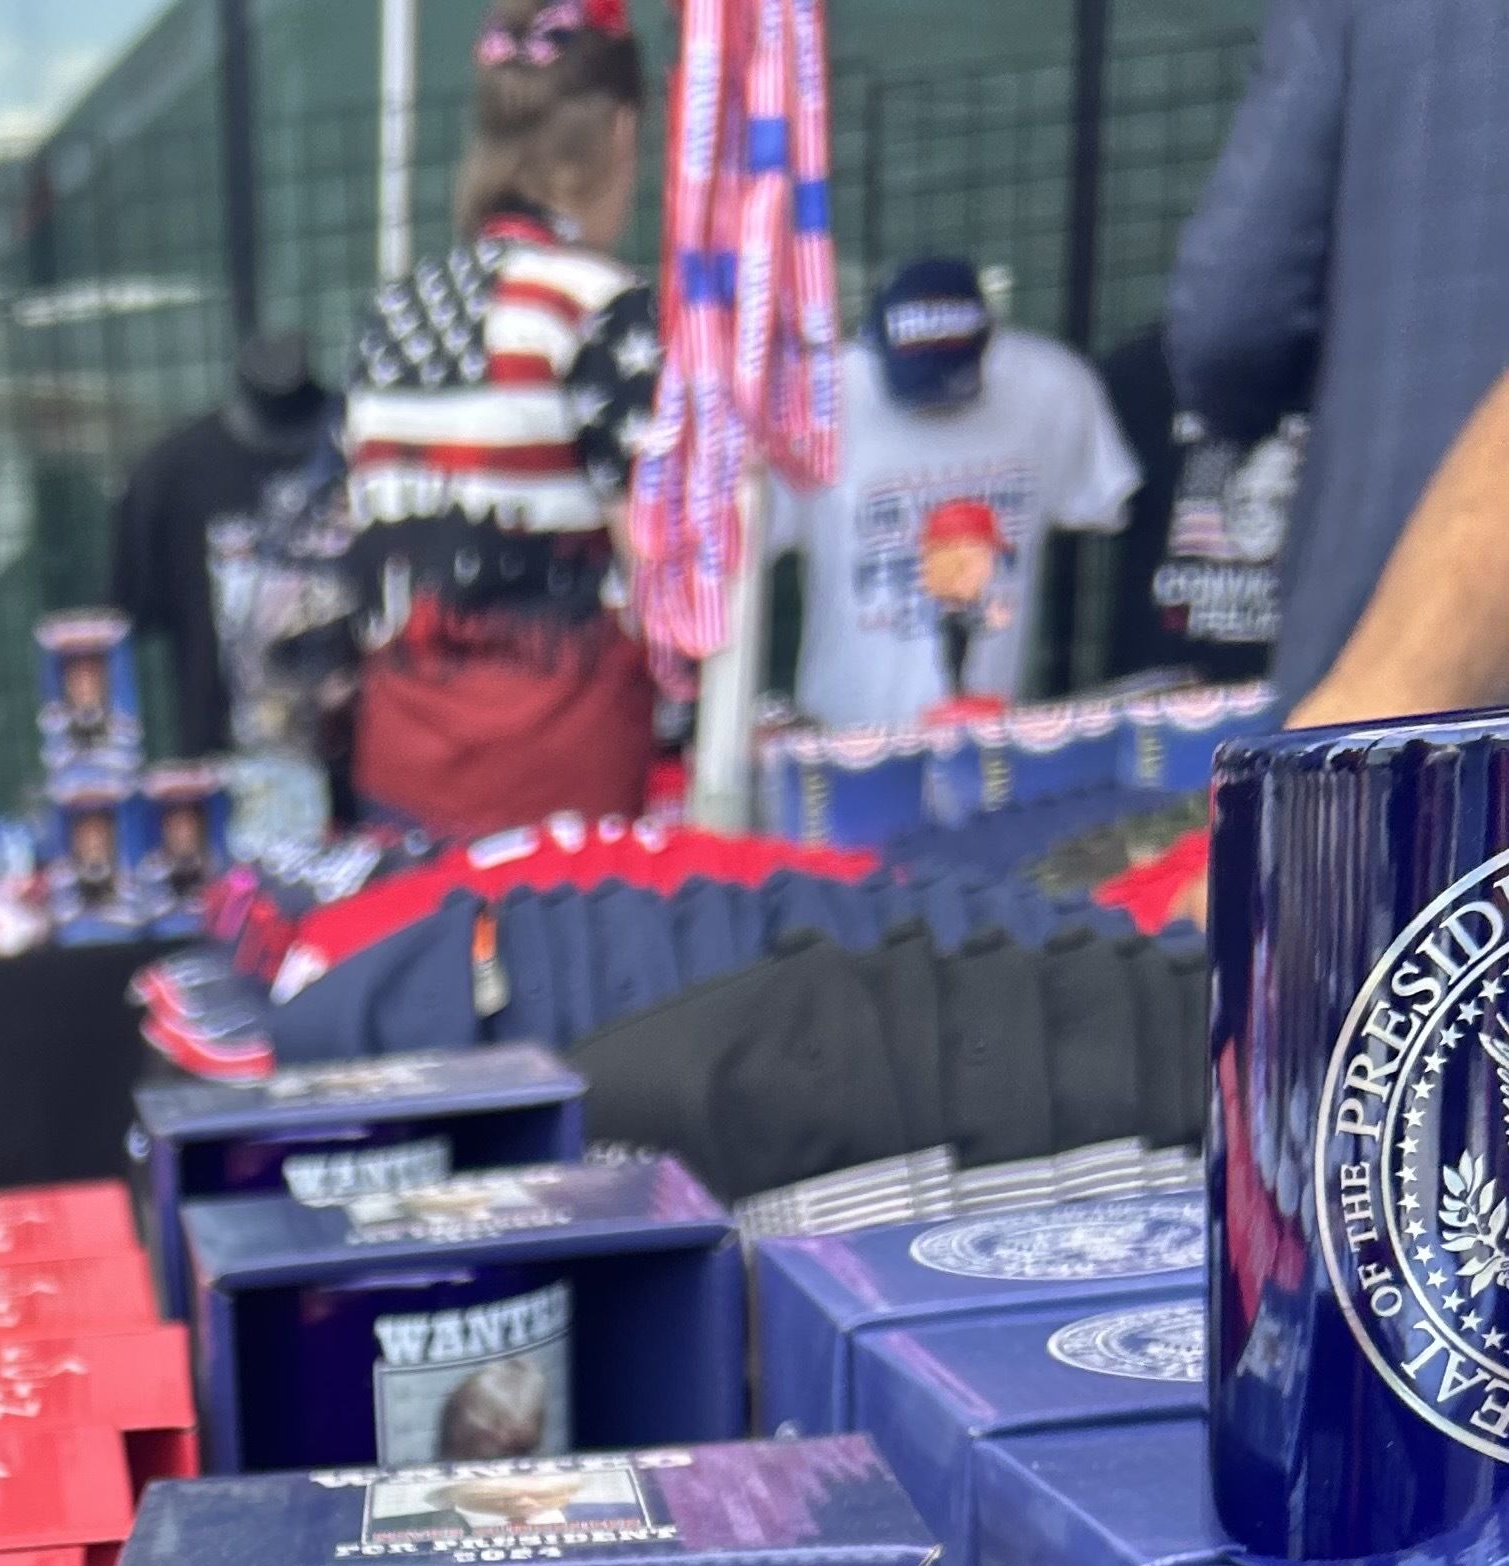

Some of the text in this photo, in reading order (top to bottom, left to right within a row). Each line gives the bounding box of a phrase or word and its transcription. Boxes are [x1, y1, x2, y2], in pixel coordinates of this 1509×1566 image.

[1335, 876, 1509, 1138] PRESID
[1341, 1162, 1379, 1253] THE
[374, 1279, 572, 1364] WANTED
[1358, 1262, 1402, 1318] OF
[335, 1525, 679, 1558] FOR PRESIDENT
